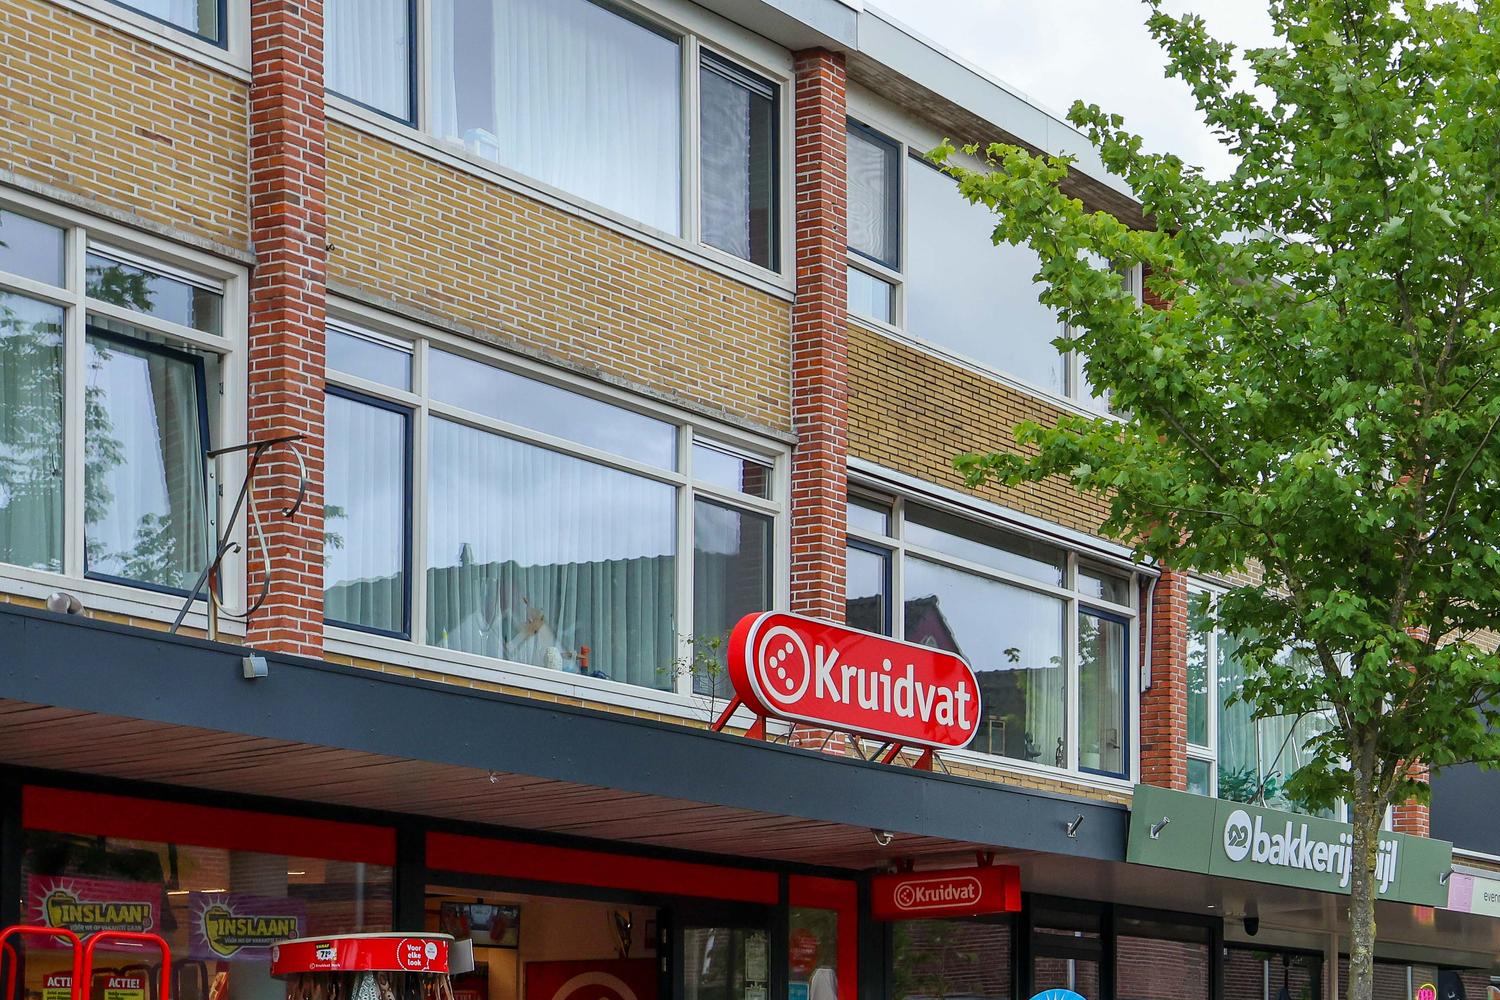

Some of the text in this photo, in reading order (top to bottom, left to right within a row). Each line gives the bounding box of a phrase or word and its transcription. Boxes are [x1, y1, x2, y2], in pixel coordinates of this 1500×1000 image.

[815, 644, 971, 730] Kruidvat
[1251, 815, 1399, 894] bakkerij ijl
[915, 883, 975, 902] Kruidvat
[61, 904, 150, 924] INSLAAN!
[217, 917, 296, 937] INSLAAN!
[407, 944, 422, 952] Voor
[407, 959, 422, 967] look
[108, 978, 141, 989] ACTIE!
